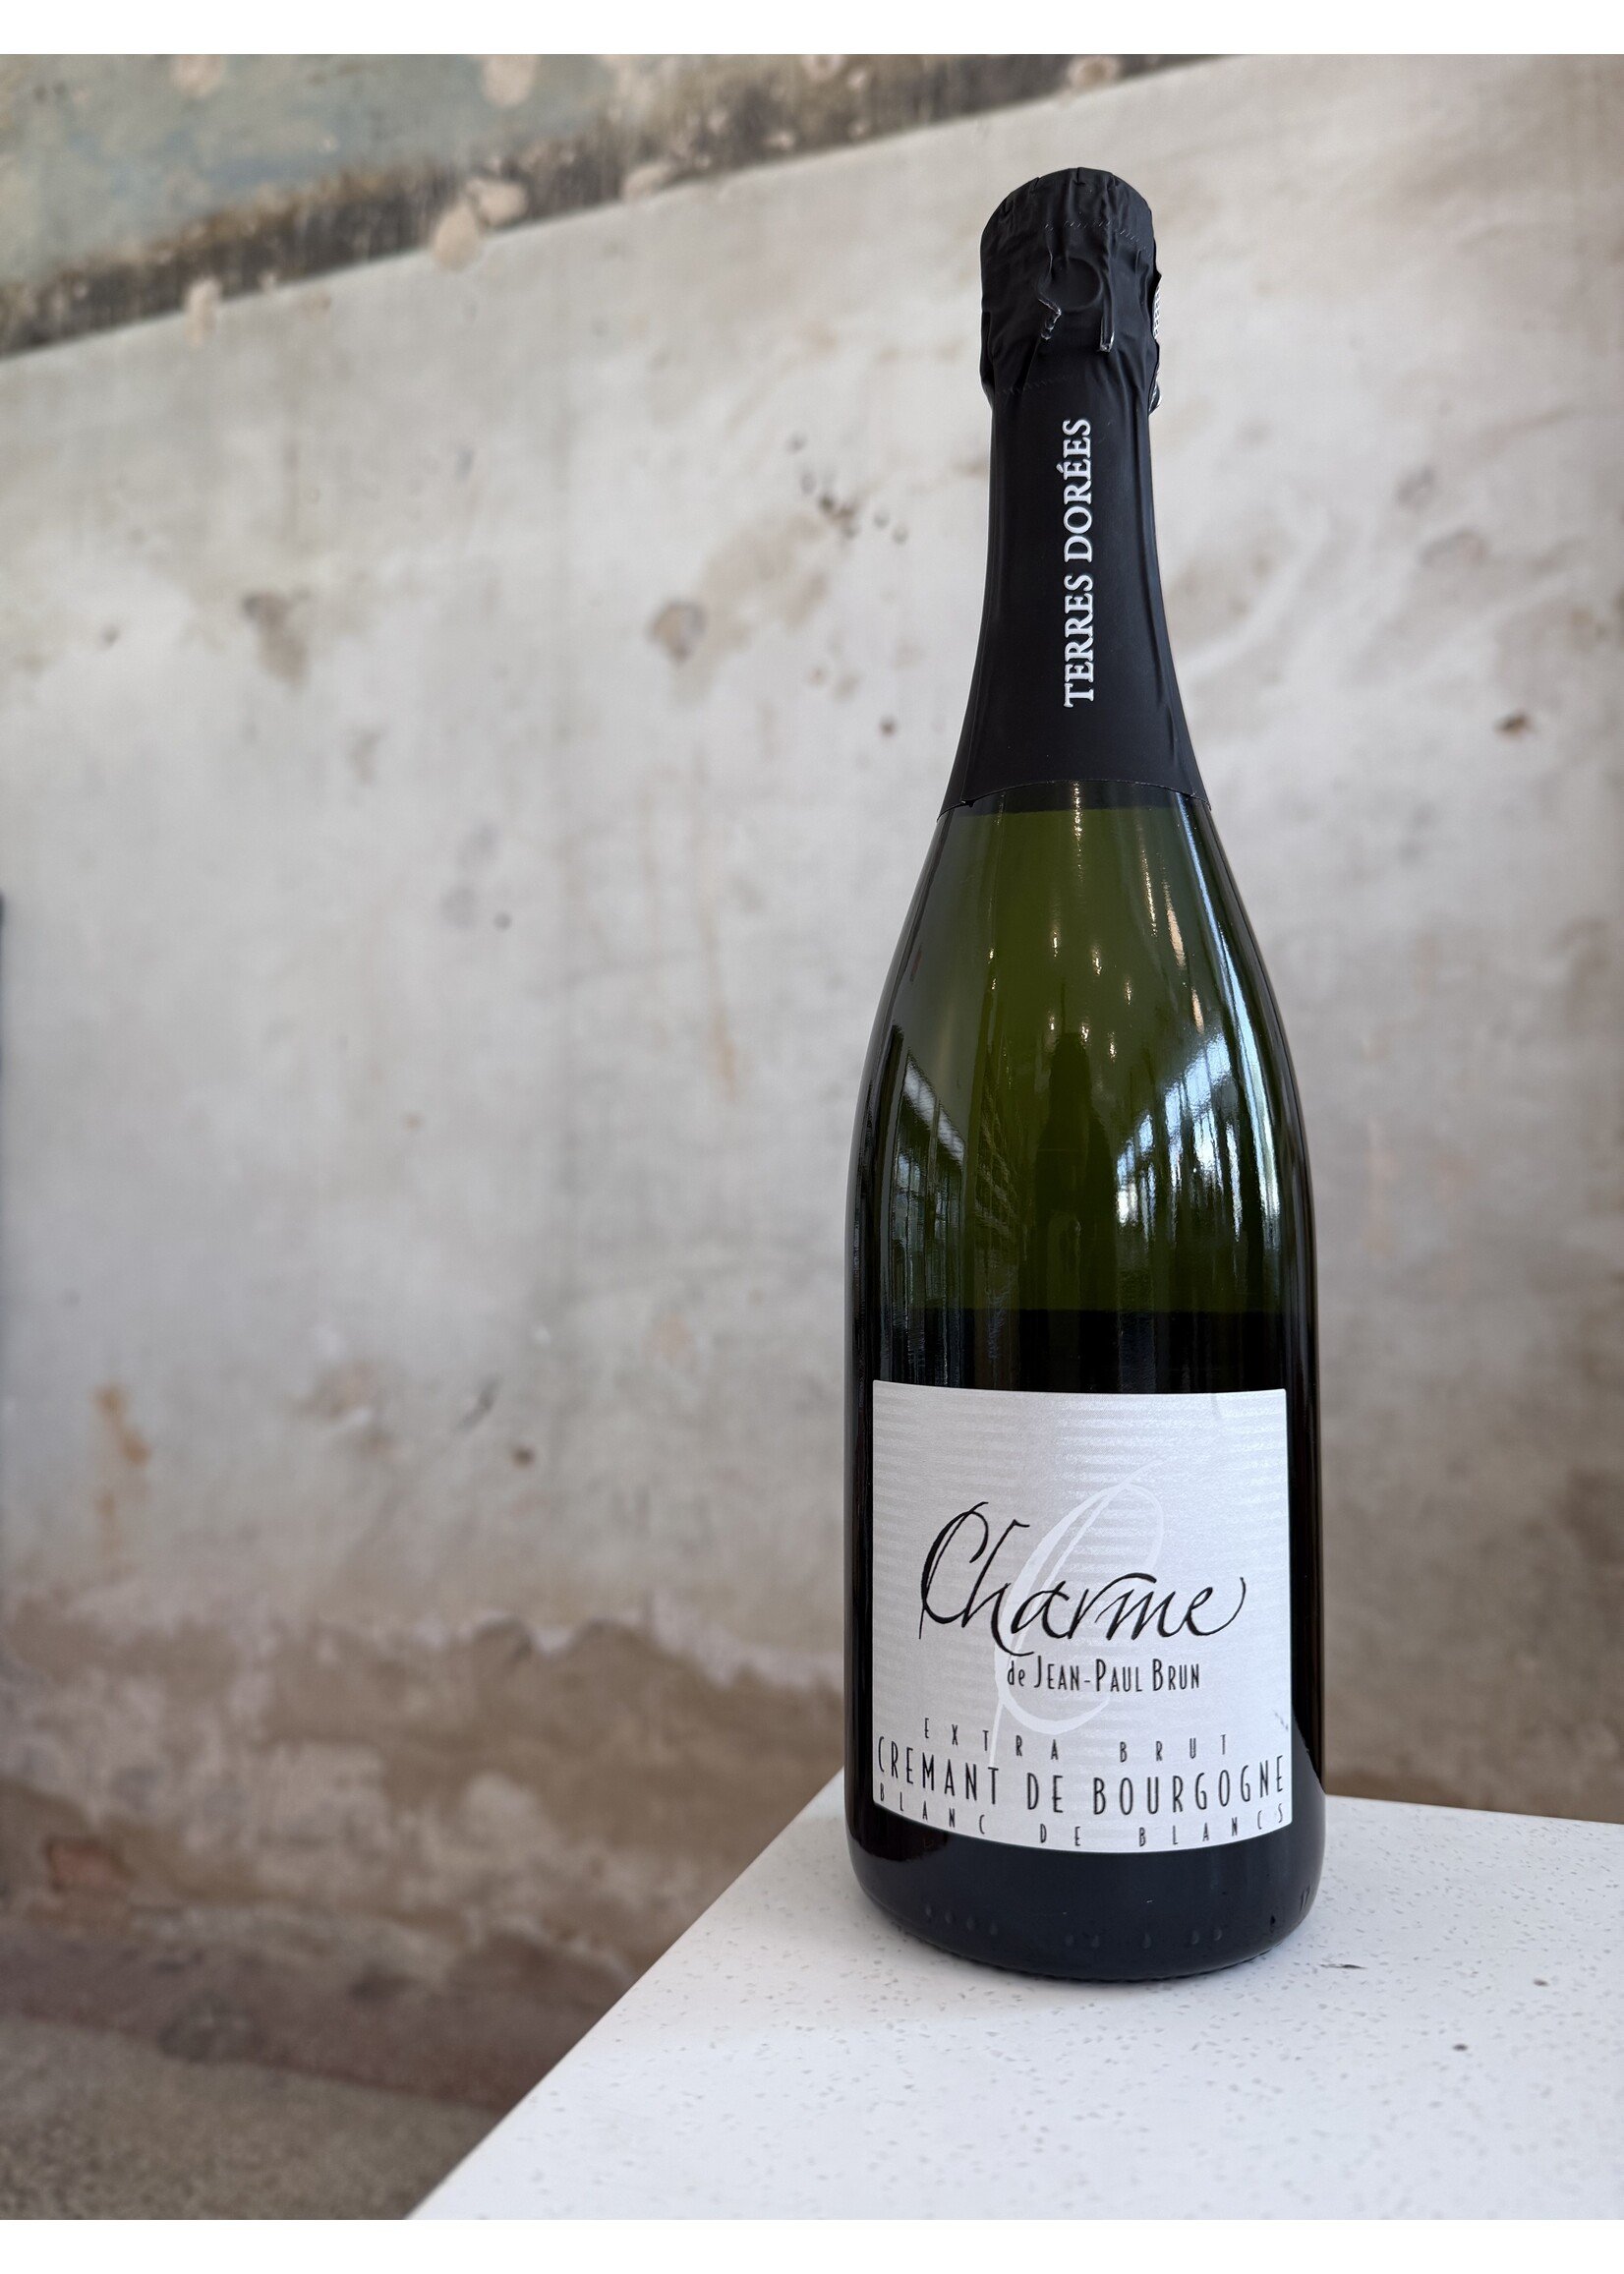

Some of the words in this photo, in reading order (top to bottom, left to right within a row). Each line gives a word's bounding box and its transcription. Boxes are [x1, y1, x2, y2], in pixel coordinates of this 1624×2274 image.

[1056, 418, 1092, 563] DORÉES
[1063, 573, 1095, 708] TERRES
[919, 1501, 1247, 1657] Charme
[1008, 1661, 1026, 1687] de
[1033, 1655, 1143, 1693] JEAN-PAUL
[1152, 1658, 1200, 1692] BRUN
[878, 1736, 1000, 1805] CREMANT
[1026, 1772, 1064, 1813] DE
[1092, 1755, 1284, 1816] BOURGOGNE
[924, 1718, 1059, 1761] EXTRA
[1119, 1733, 1227, 1763] BRUT
[880, 1782, 986, 1836] BLANC
[1039, 1824, 1081, 1846] DE
[1138, 1803, 1284, 1847] BLANCS
